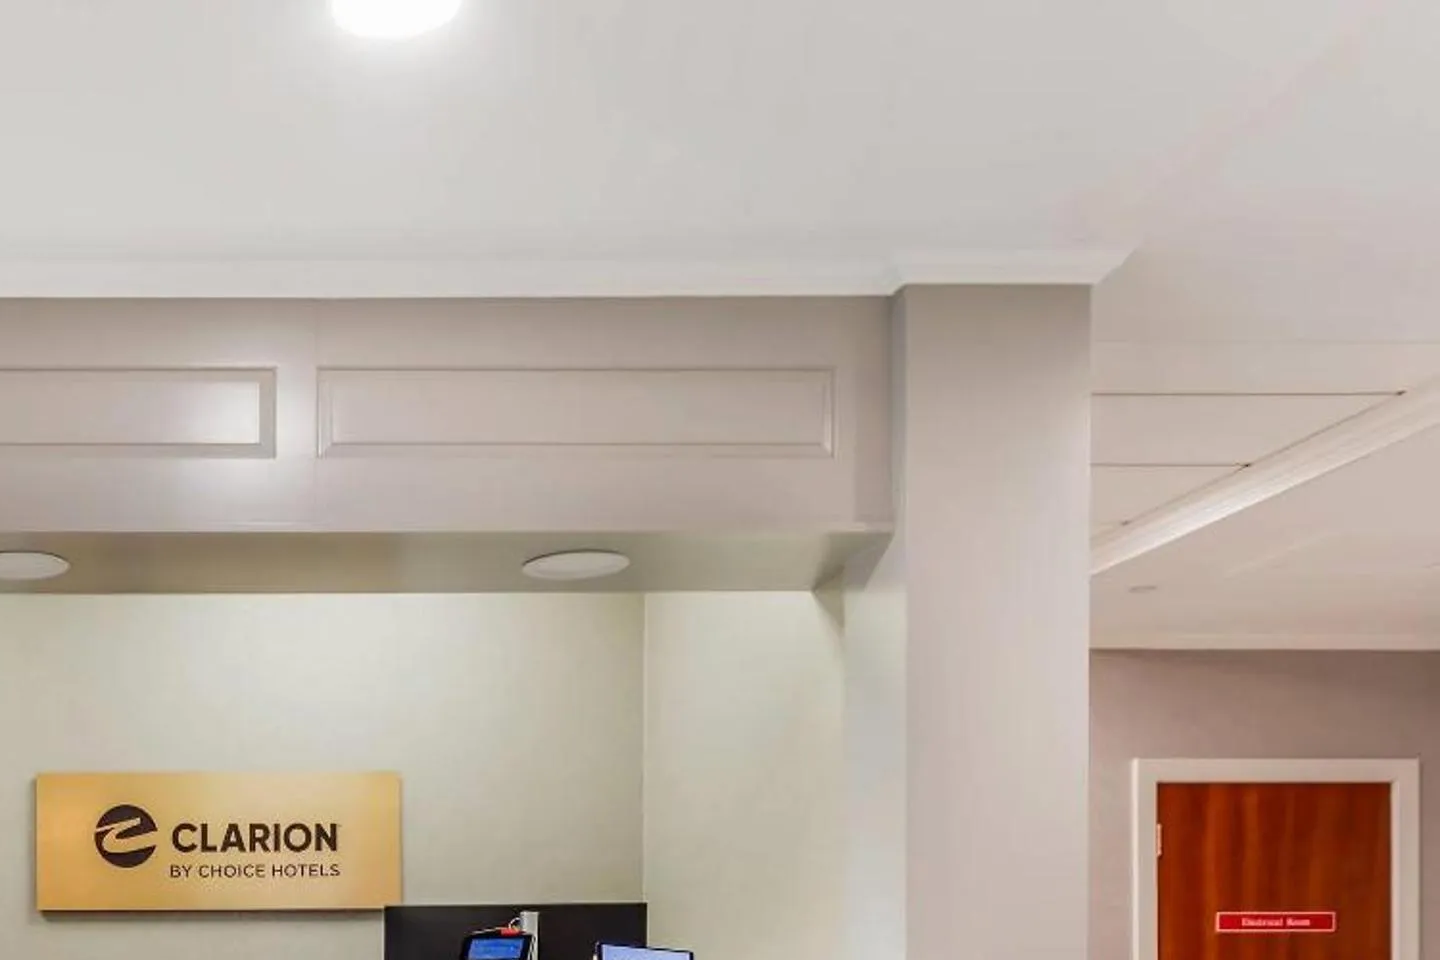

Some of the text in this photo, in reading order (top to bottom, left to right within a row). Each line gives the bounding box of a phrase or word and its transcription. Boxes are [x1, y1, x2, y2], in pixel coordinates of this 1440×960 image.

[171, 822, 338, 853] CLARION
[169, 863, 341, 879] BY CHOICE HOTELS
